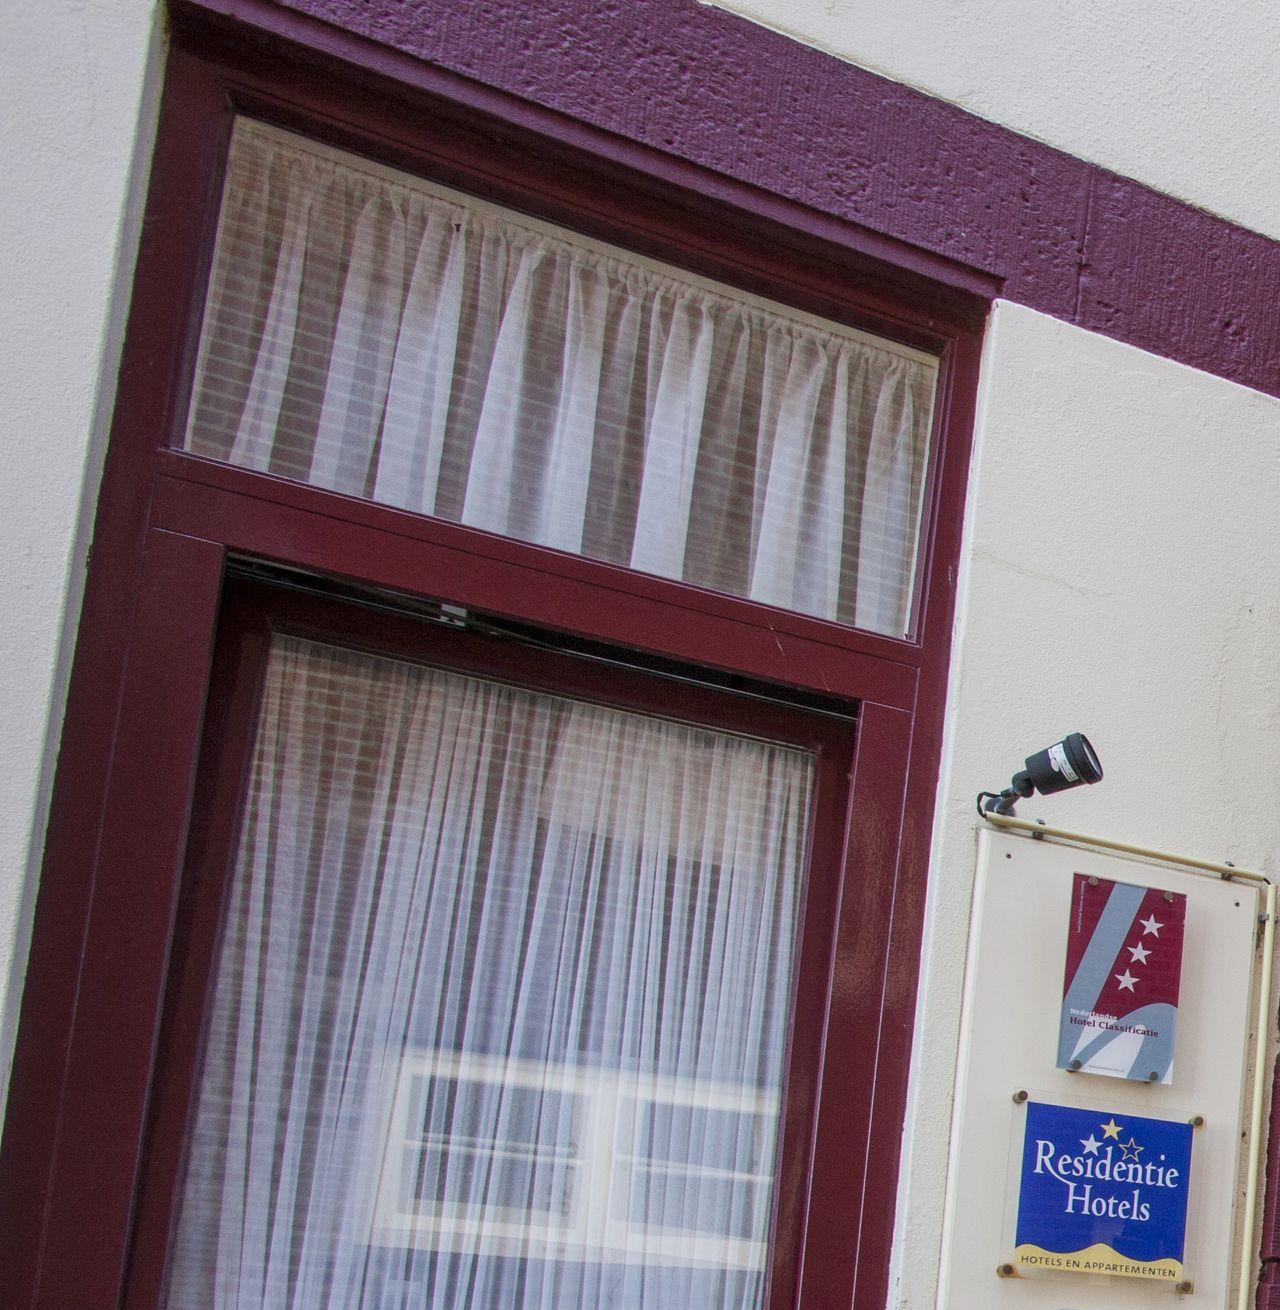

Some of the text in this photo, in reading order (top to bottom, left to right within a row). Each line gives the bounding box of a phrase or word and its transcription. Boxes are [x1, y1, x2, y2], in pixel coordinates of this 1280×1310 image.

[1069, 1008, 1118, 1020] Nederlandse
[1069, 1016, 1159, 1038] Hotel Classificatie
[1033, 1139, 1180, 1188] Residentie
[1065, 1182, 1150, 1221] Hotels
[1021, 1255, 1176, 1277] HOTELS EN APPARTEMENTEN
